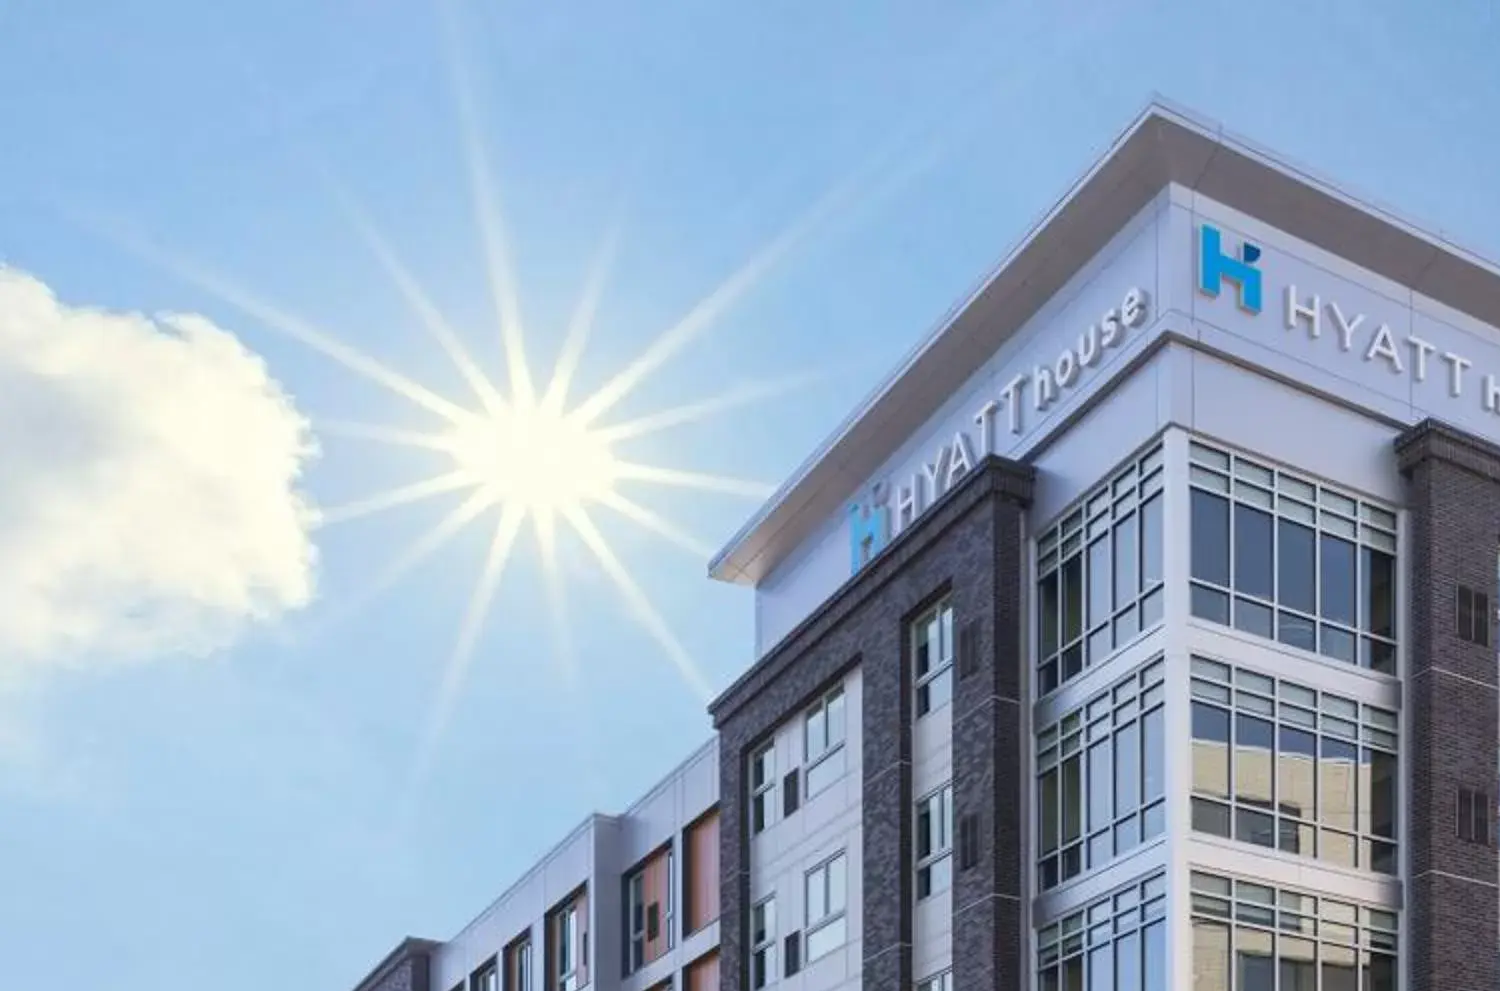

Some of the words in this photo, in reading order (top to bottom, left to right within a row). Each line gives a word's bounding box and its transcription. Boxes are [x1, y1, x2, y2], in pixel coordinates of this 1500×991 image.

[891, 373, 1028, 531] HYATT
[1034, 286, 1148, 411] house
[1284, 284, 1472, 397] HYATT
